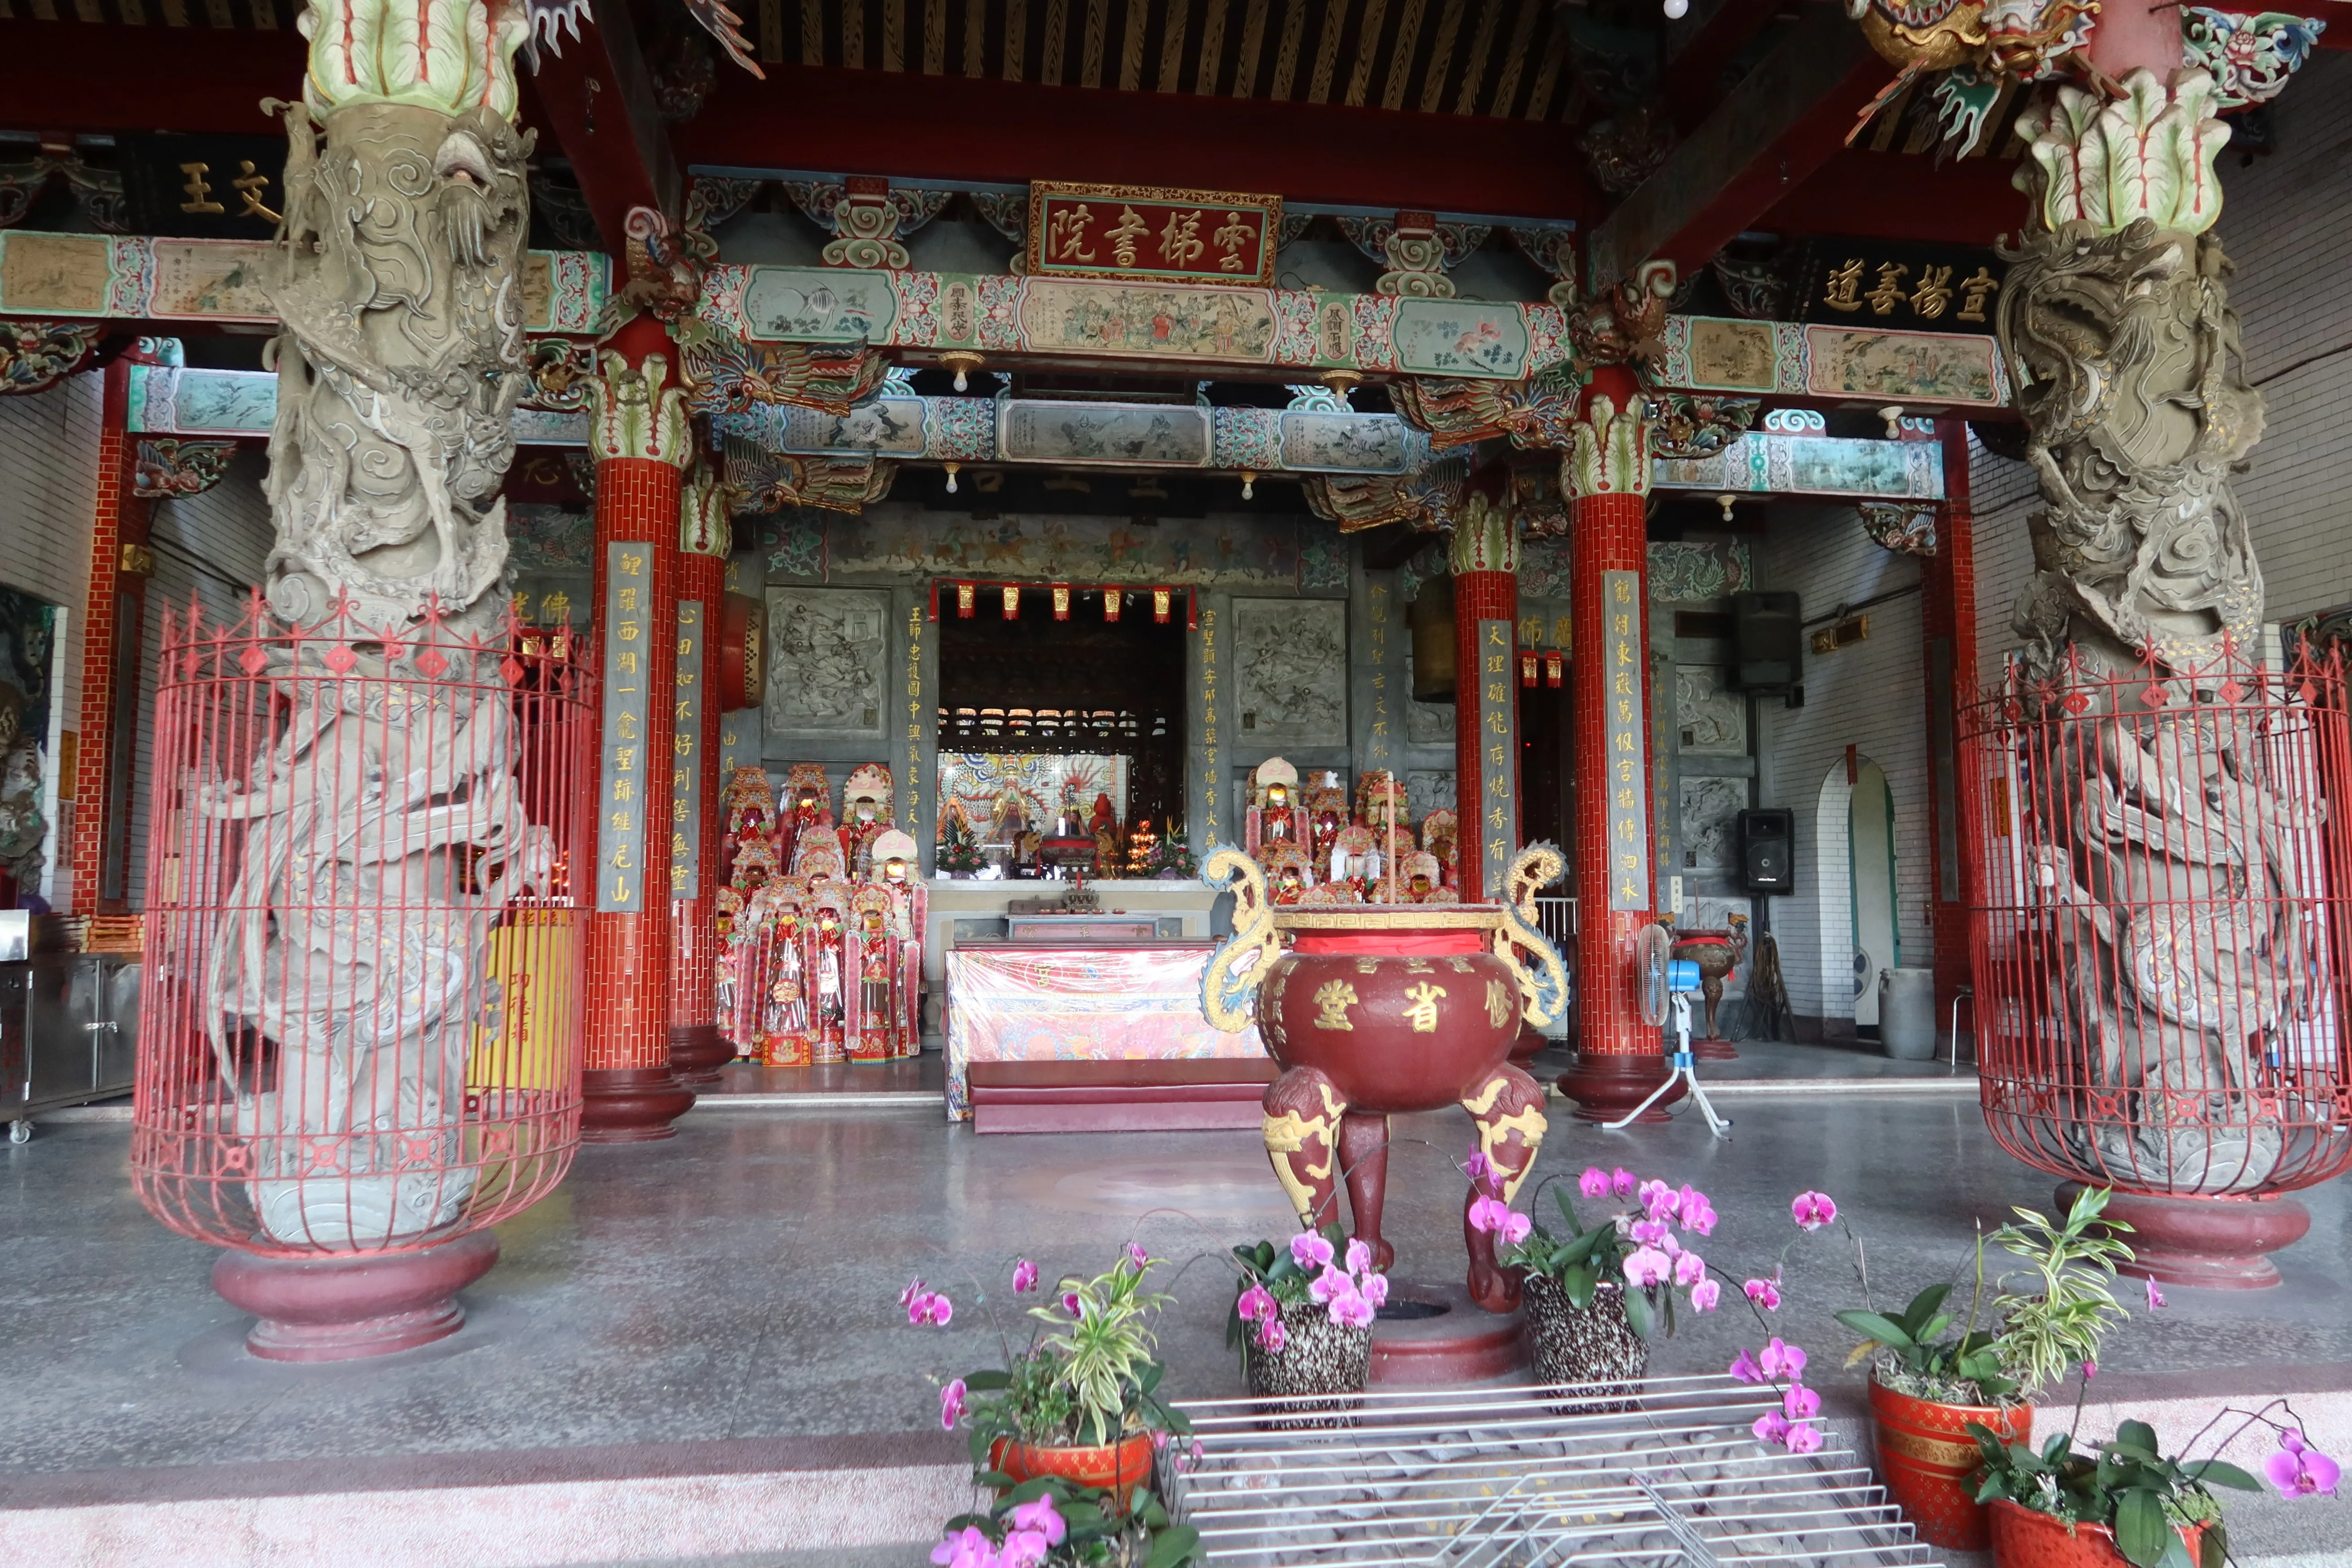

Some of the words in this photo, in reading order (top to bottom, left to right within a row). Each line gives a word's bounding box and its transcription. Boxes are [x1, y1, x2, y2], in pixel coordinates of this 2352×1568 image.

[1049, 204, 1256, 270] 雲梯書院
[949, 288, 967, 336] 國泰民安
[1823, 259, 1999, 322] 宣揚善道
[1326, 309, 1345, 356] 風調雨順
